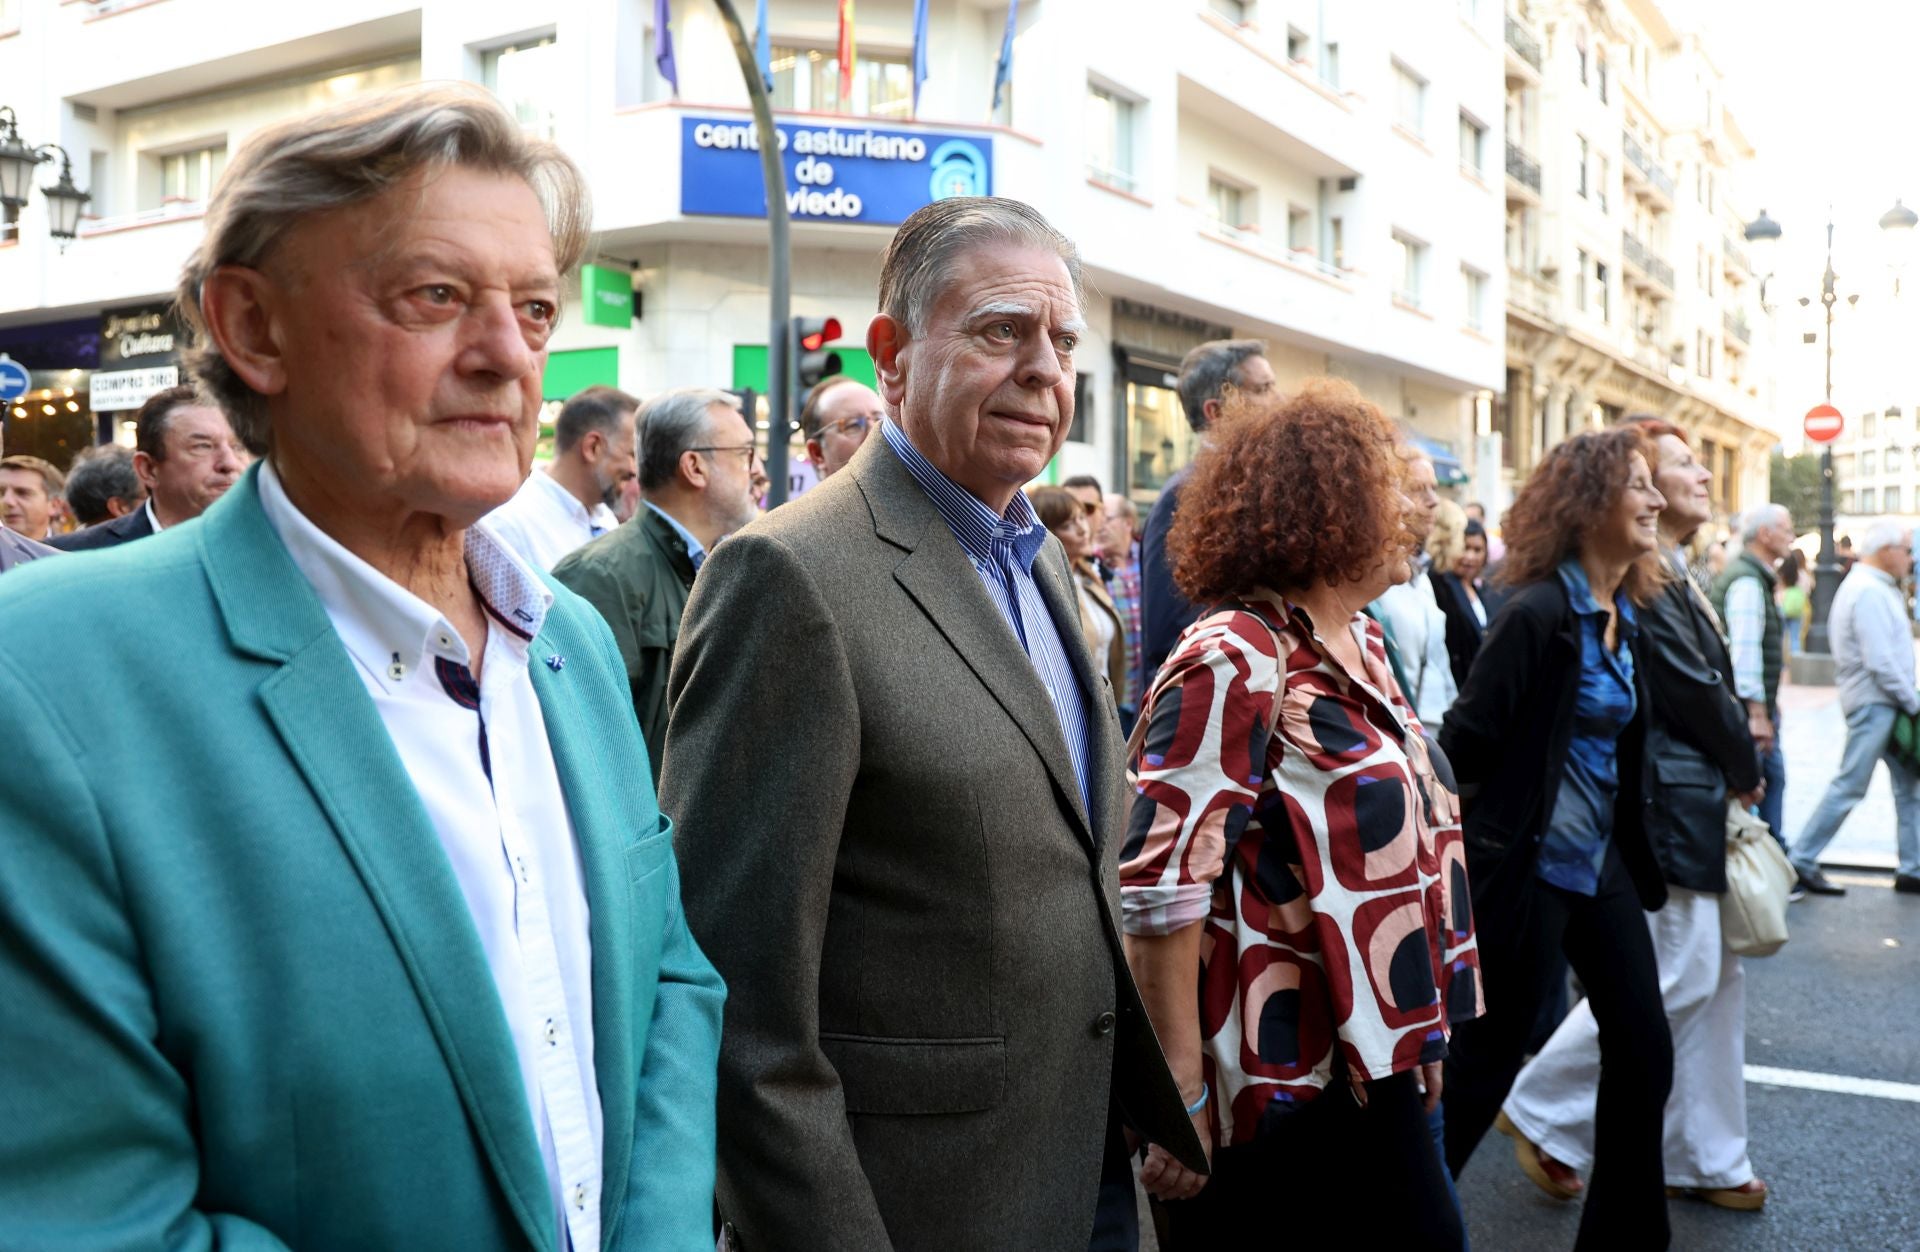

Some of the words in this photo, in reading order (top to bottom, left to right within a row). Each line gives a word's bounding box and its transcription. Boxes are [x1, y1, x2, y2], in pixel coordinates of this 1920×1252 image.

[694, 122, 788, 152] cento
[793, 129, 926, 162] asturiano
[795, 156, 834, 185] de
[769, 189, 862, 217] viedo
[93, 376, 143, 391] COMPRO
[149, 373, 172, 386] ORO
